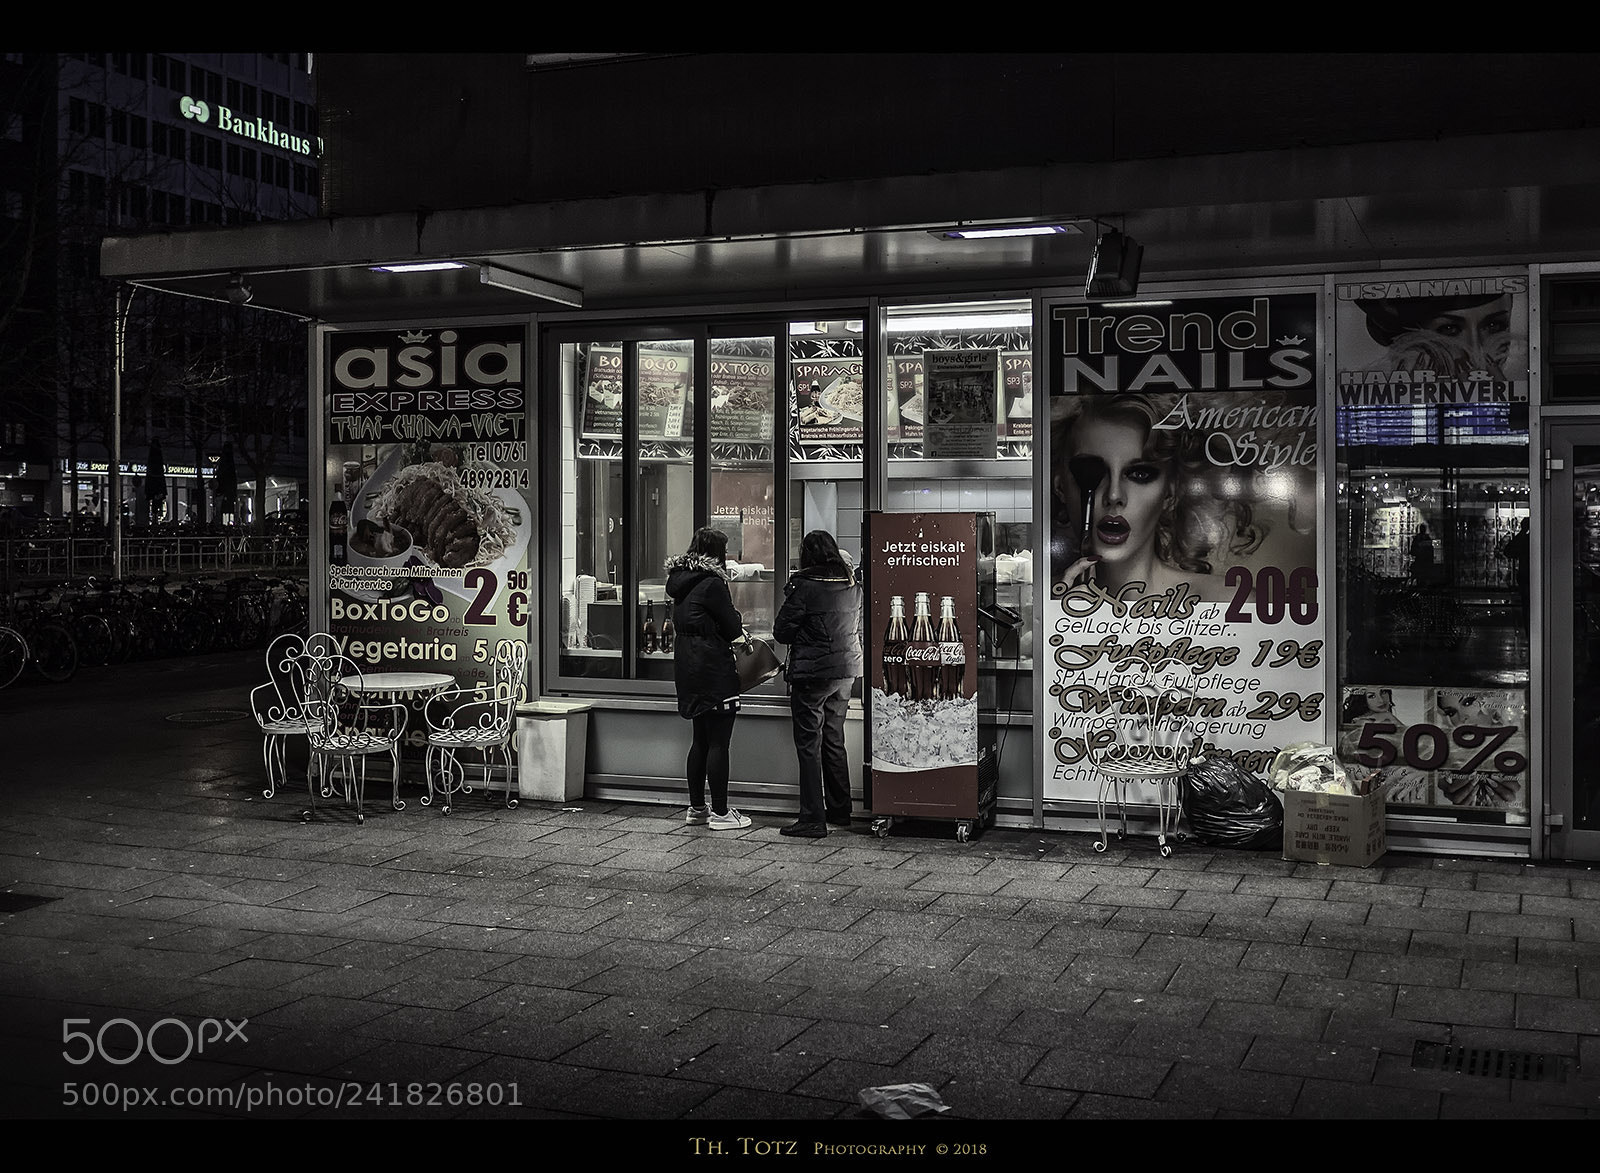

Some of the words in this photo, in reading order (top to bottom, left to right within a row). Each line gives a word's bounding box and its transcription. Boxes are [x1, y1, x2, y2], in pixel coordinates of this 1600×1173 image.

[218, 105, 310, 155] Bankhaus
[1337, 283, 1413, 301] USA
[1419, 277, 1527, 297] NAILS
[1053, 298, 1269, 354] Trend
[334, 330, 521, 388] asia
[1064, 349, 1312, 392] NAILS
[798, 383, 811, 392] SP1
[900, 381, 913, 389] SP2
[1007, 376, 1020, 386] SP3
[1340, 381, 1528, 404] WIMPERNVERL.
[333, 388, 523, 413] EXPRESS
[1152, 394, 1318, 430] American
[469, 442, 490, 462] Tel
[493, 442, 528, 462] 0761
[1205, 431, 1317, 477] Style
[460, 469, 529, 489] 48992814
[714, 506, 738, 515] Jetzt
[882, 541, 916, 553] Jetzt
[920, 541, 965, 553] eiskalt
[330, 564, 364, 577] Speisen
[365, 565, 389, 577] auch
[391, 567, 410, 577] zum
[411, 565, 462, 578] Mitnehmen
[887, 555, 960, 567] erfrischen!
[330, 579, 338, 590] &
[340, 579, 393, 591] Partyservice
[463, 568, 498, 626] 2
[1061, 577, 1202, 619] Nails
[1199, 604, 1220, 619] ab
[1225, 566, 1319, 625] 20€
[331, 598, 450, 623] BoxToGo
[507, 592, 528, 626] €
[427, 627, 469, 637] Bratreis
[1055, 618, 1130, 635] GelLack
[1137, 619, 1162, 635] bis
[333, 636, 457, 664] Vegetaria
[884, 655, 903, 663] zero
[905, 646, 940, 661] Coca-Cola
[1252, 639, 1324, 669] 19€
[1226, 701, 1247, 717] ab
[1246, 691, 1325, 722] 29€
[1358, 723, 1527, 774] 50%
